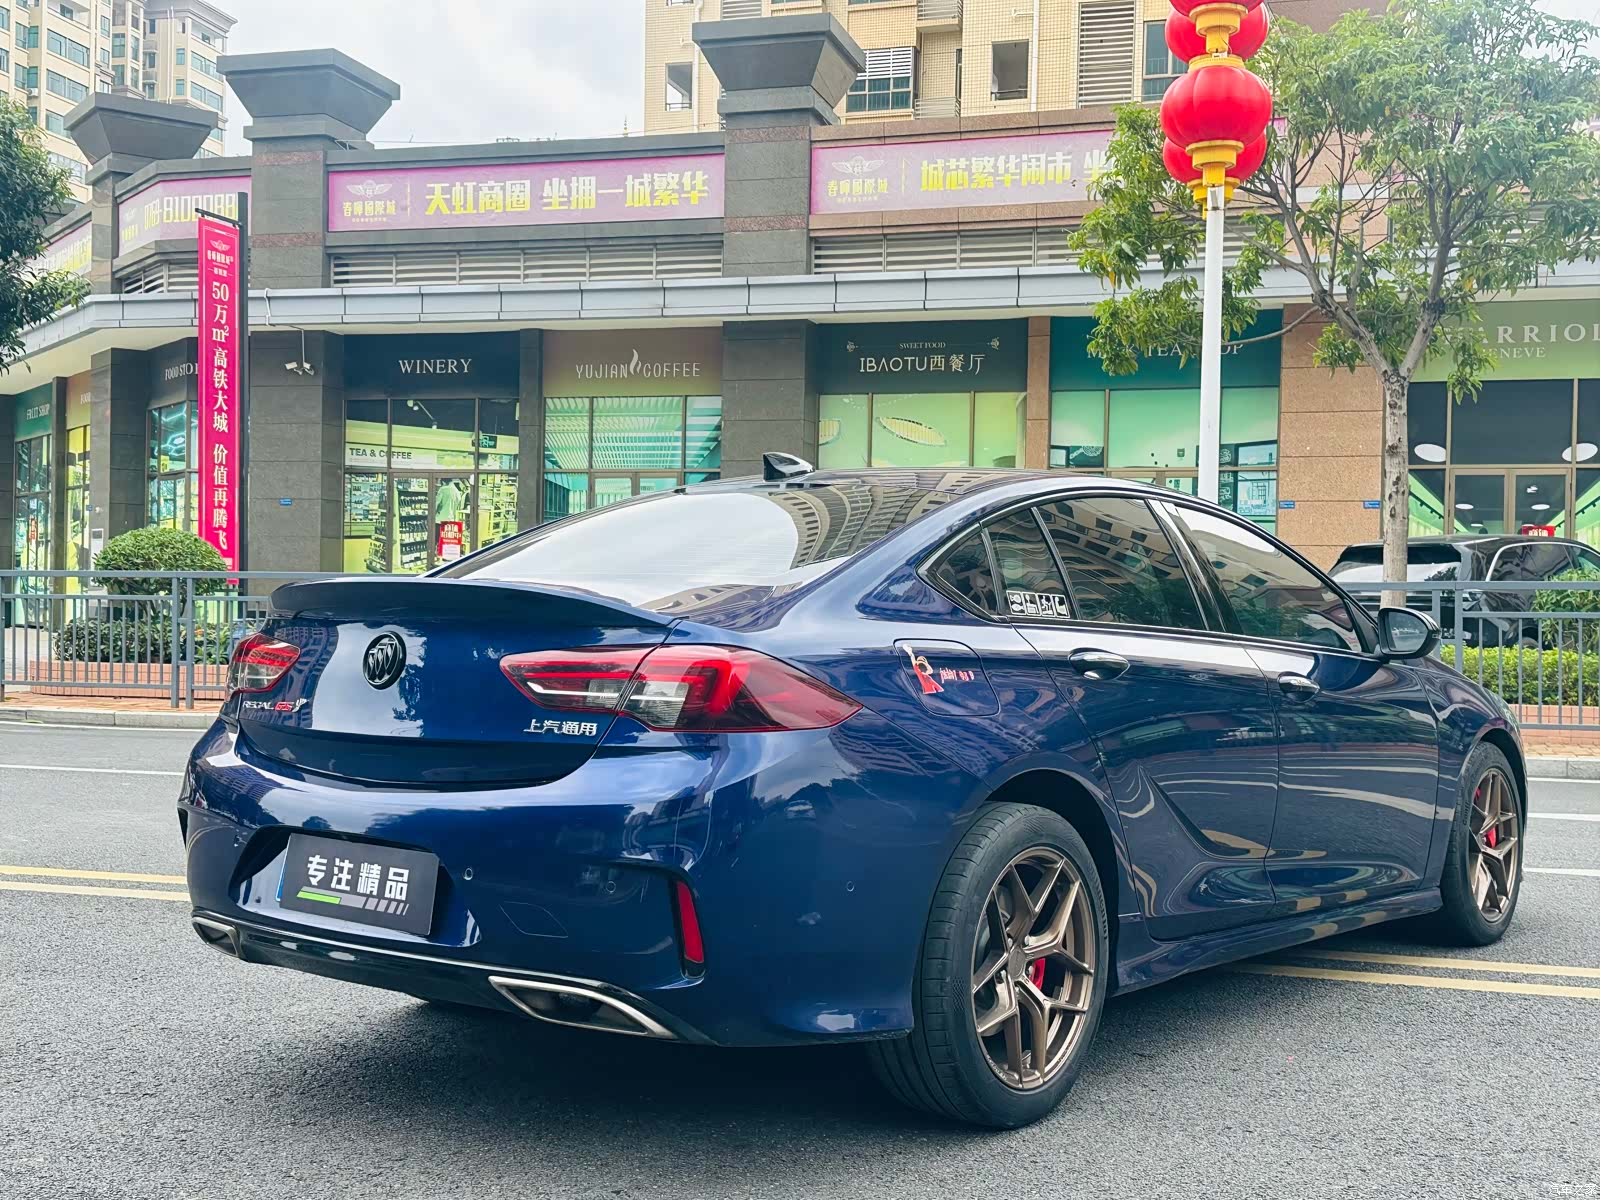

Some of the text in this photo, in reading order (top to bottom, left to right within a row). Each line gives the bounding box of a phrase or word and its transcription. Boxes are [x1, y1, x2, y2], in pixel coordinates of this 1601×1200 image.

[920, 151, 1073, 192] 城芯繁华闹市
[425, 170, 709, 216] 天虹商圈 坐拥一城繁华
[900, 341, 947, 350] SWEET FOOD
[1482, 347, 1546, 359] ENEVE
[398, 358, 472, 376] WINERY
[575, 362, 702, 380] YUJIAN COFFEE
[349, 447, 368, 457] TEA
[369, 449, 377, 458] &
[212, 443, 229, 550] 价值再腾飞
[242, 700, 275, 710] REGAL
[522, 718, 598, 737] 上汽通用
[307, 854, 410, 901] 专注精品
